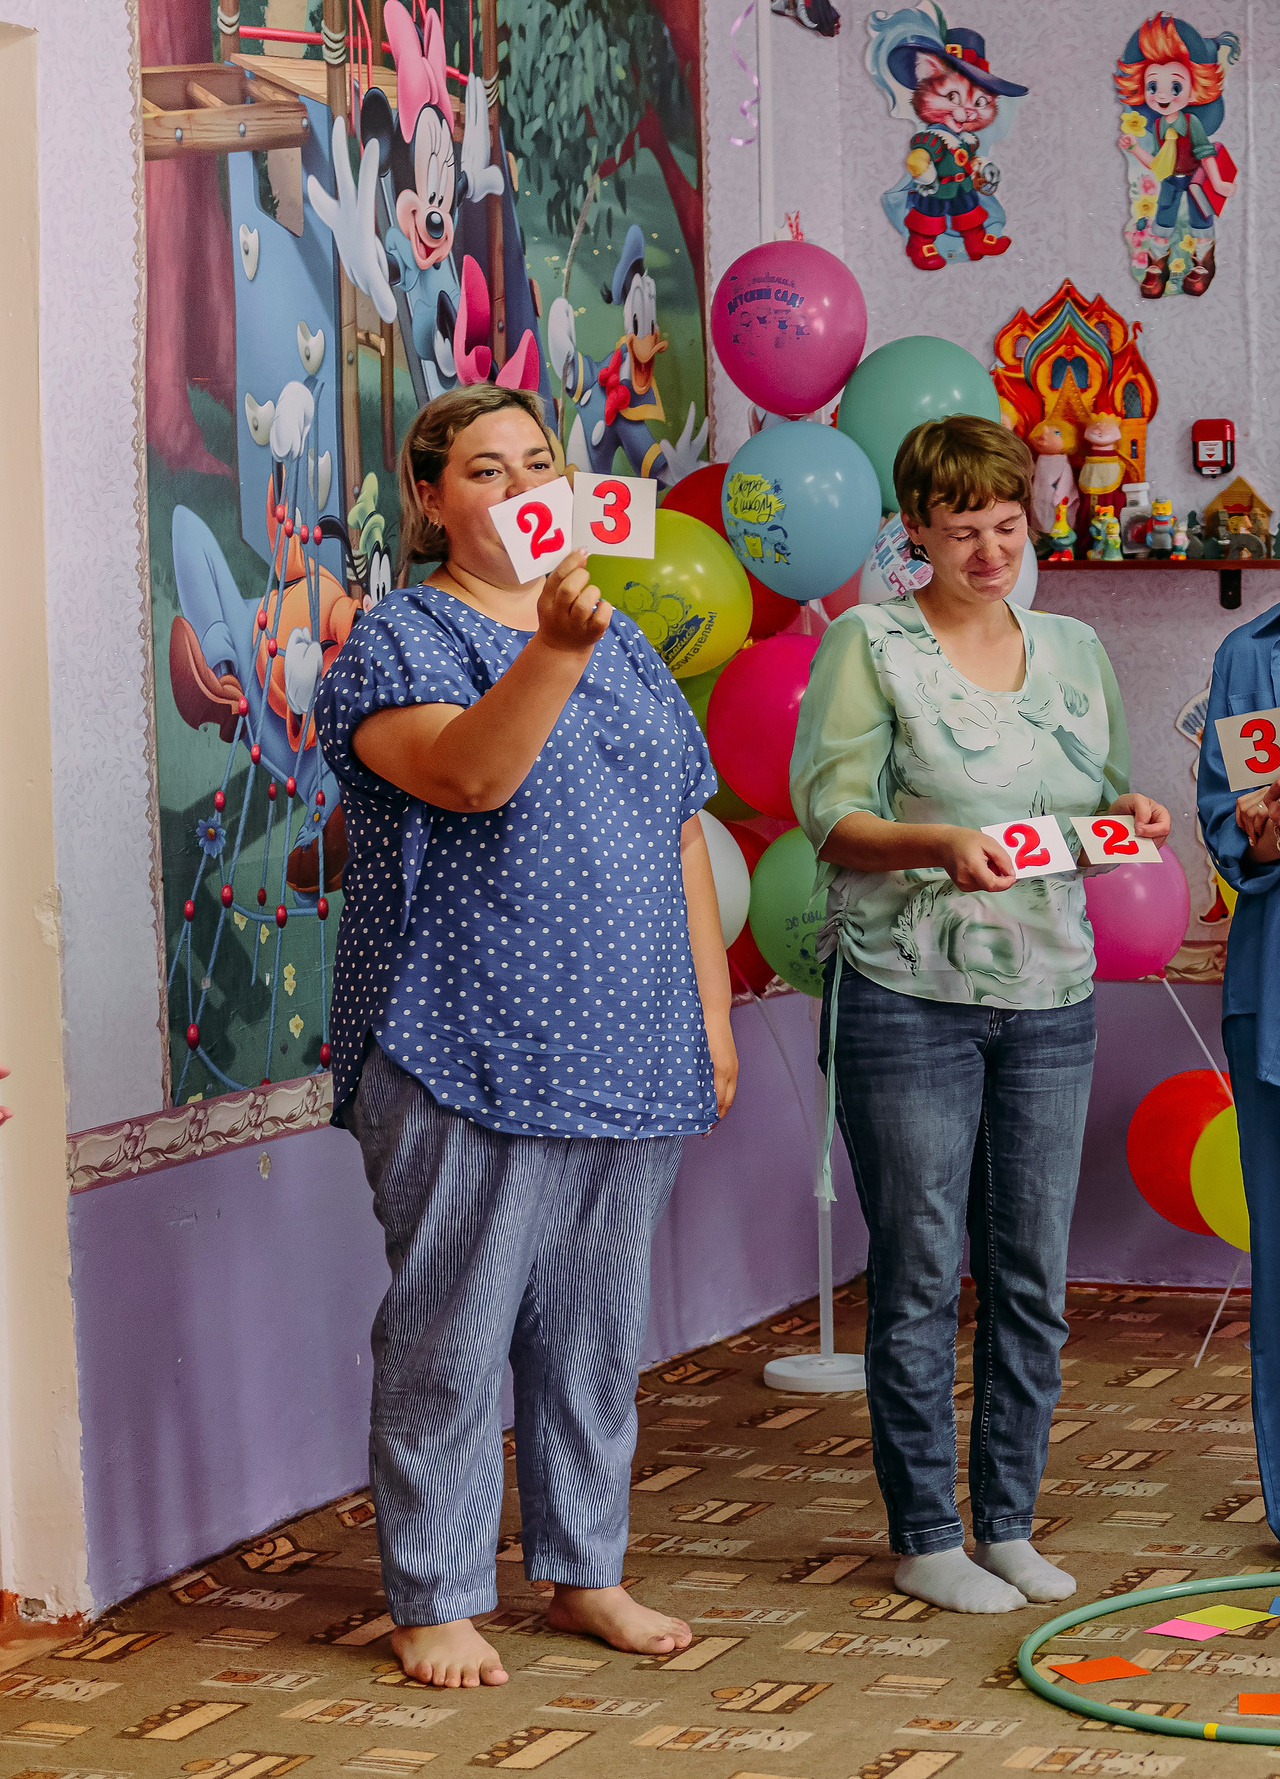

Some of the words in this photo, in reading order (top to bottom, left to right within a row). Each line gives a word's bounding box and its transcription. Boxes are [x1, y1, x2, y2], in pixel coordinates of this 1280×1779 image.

[774, 289, 804, 308] САД!
[732, 472, 764, 497] Скоро
[590, 479, 631, 544] 3
[740, 493, 775, 525] школу
[517, 501, 565, 560] 2
[1003, 823, 1050, 870] 2
[1091, 819, 1139, 855] 2
